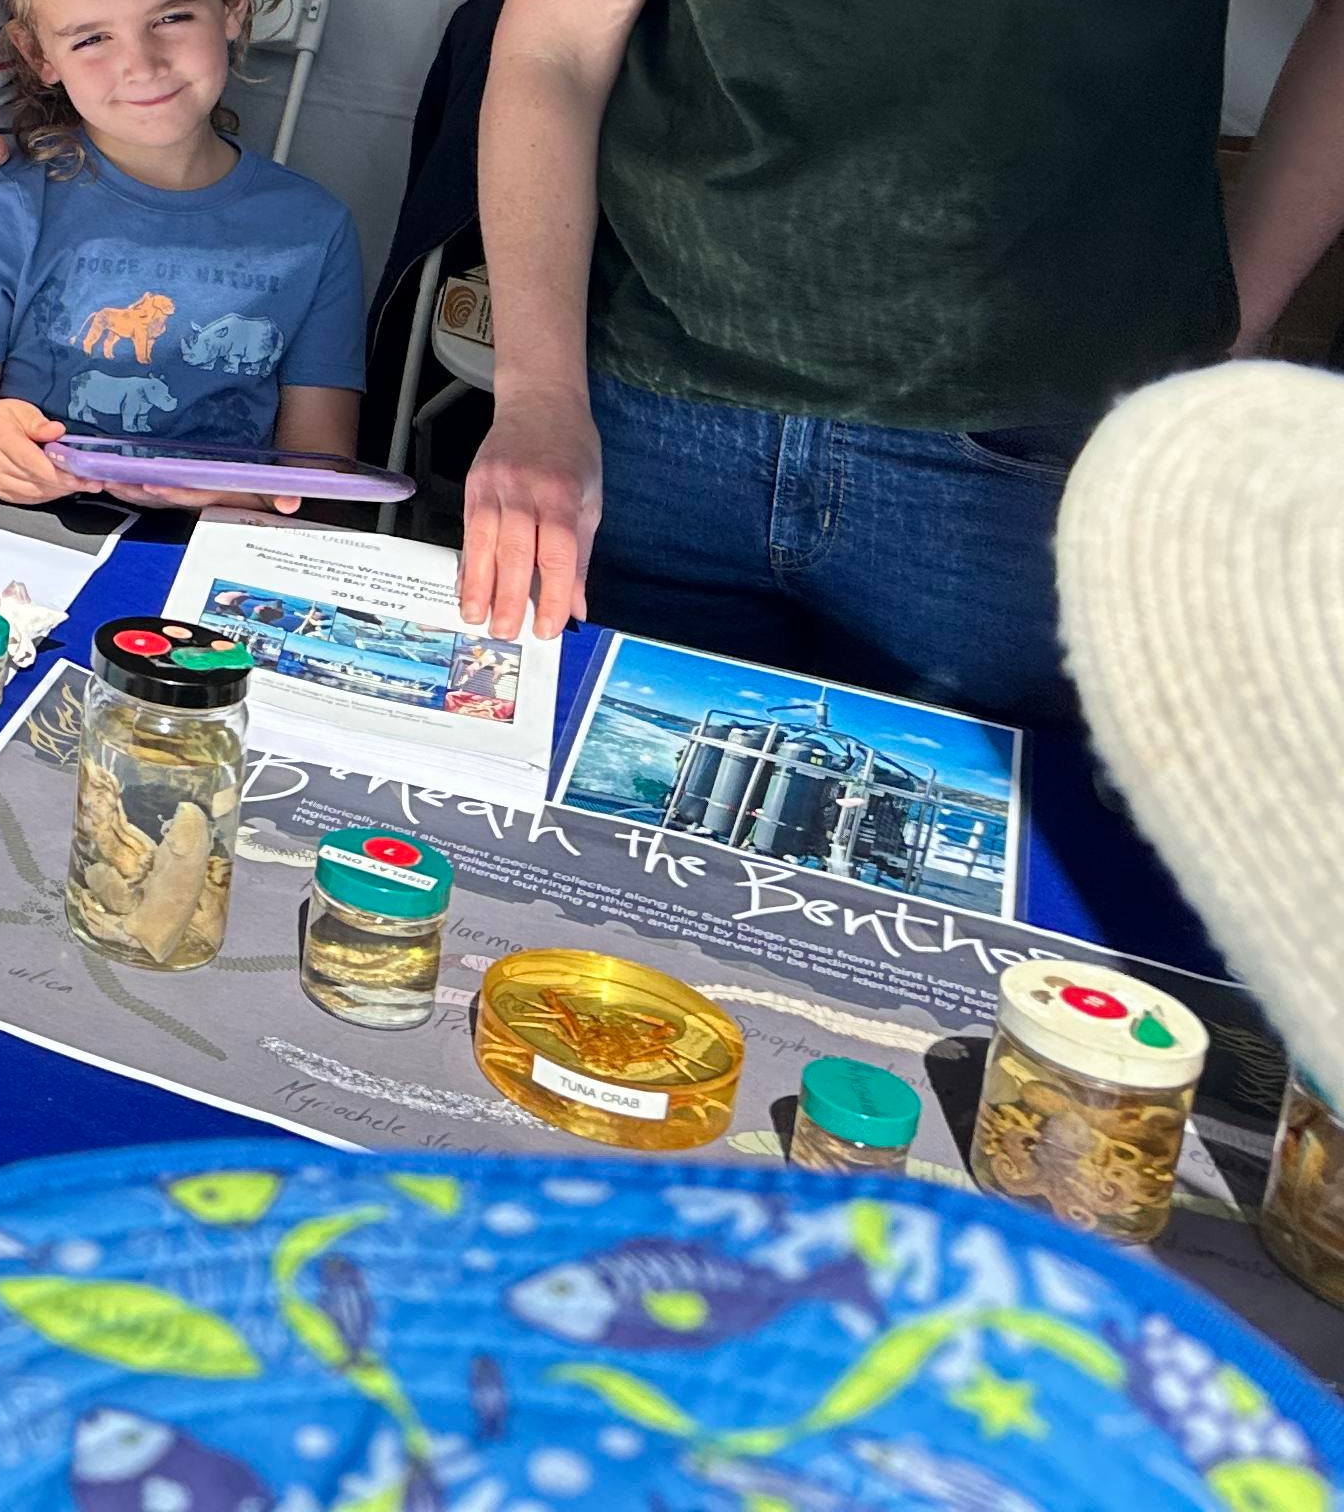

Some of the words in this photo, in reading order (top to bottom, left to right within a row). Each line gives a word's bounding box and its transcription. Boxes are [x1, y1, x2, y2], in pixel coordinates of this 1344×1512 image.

[615, 829, 707, 888] the
[369, 865, 431, 887] DISPLAY
[559, 1076, 597, 1100] TUNA
[601, 1087, 640, 1109] CRAB
